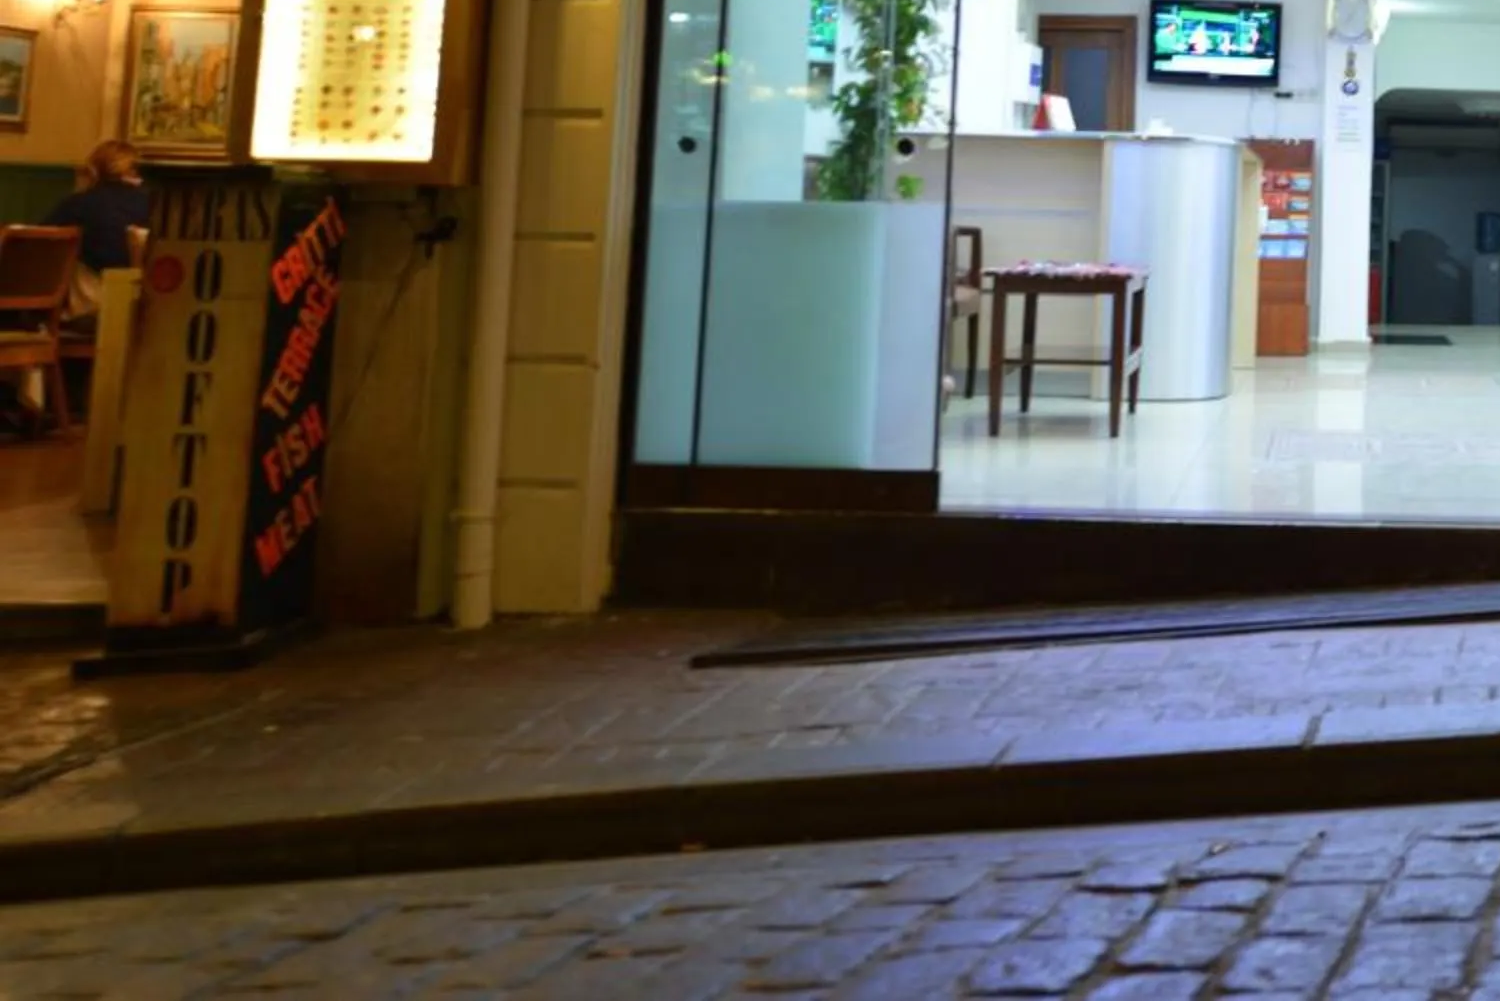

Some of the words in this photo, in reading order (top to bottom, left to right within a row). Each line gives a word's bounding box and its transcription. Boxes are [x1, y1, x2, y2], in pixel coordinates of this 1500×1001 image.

[261, 270, 342, 418] TERRACE
[262, 403, 326, 493] FISH
[254, 476, 322, 577] MEAT
